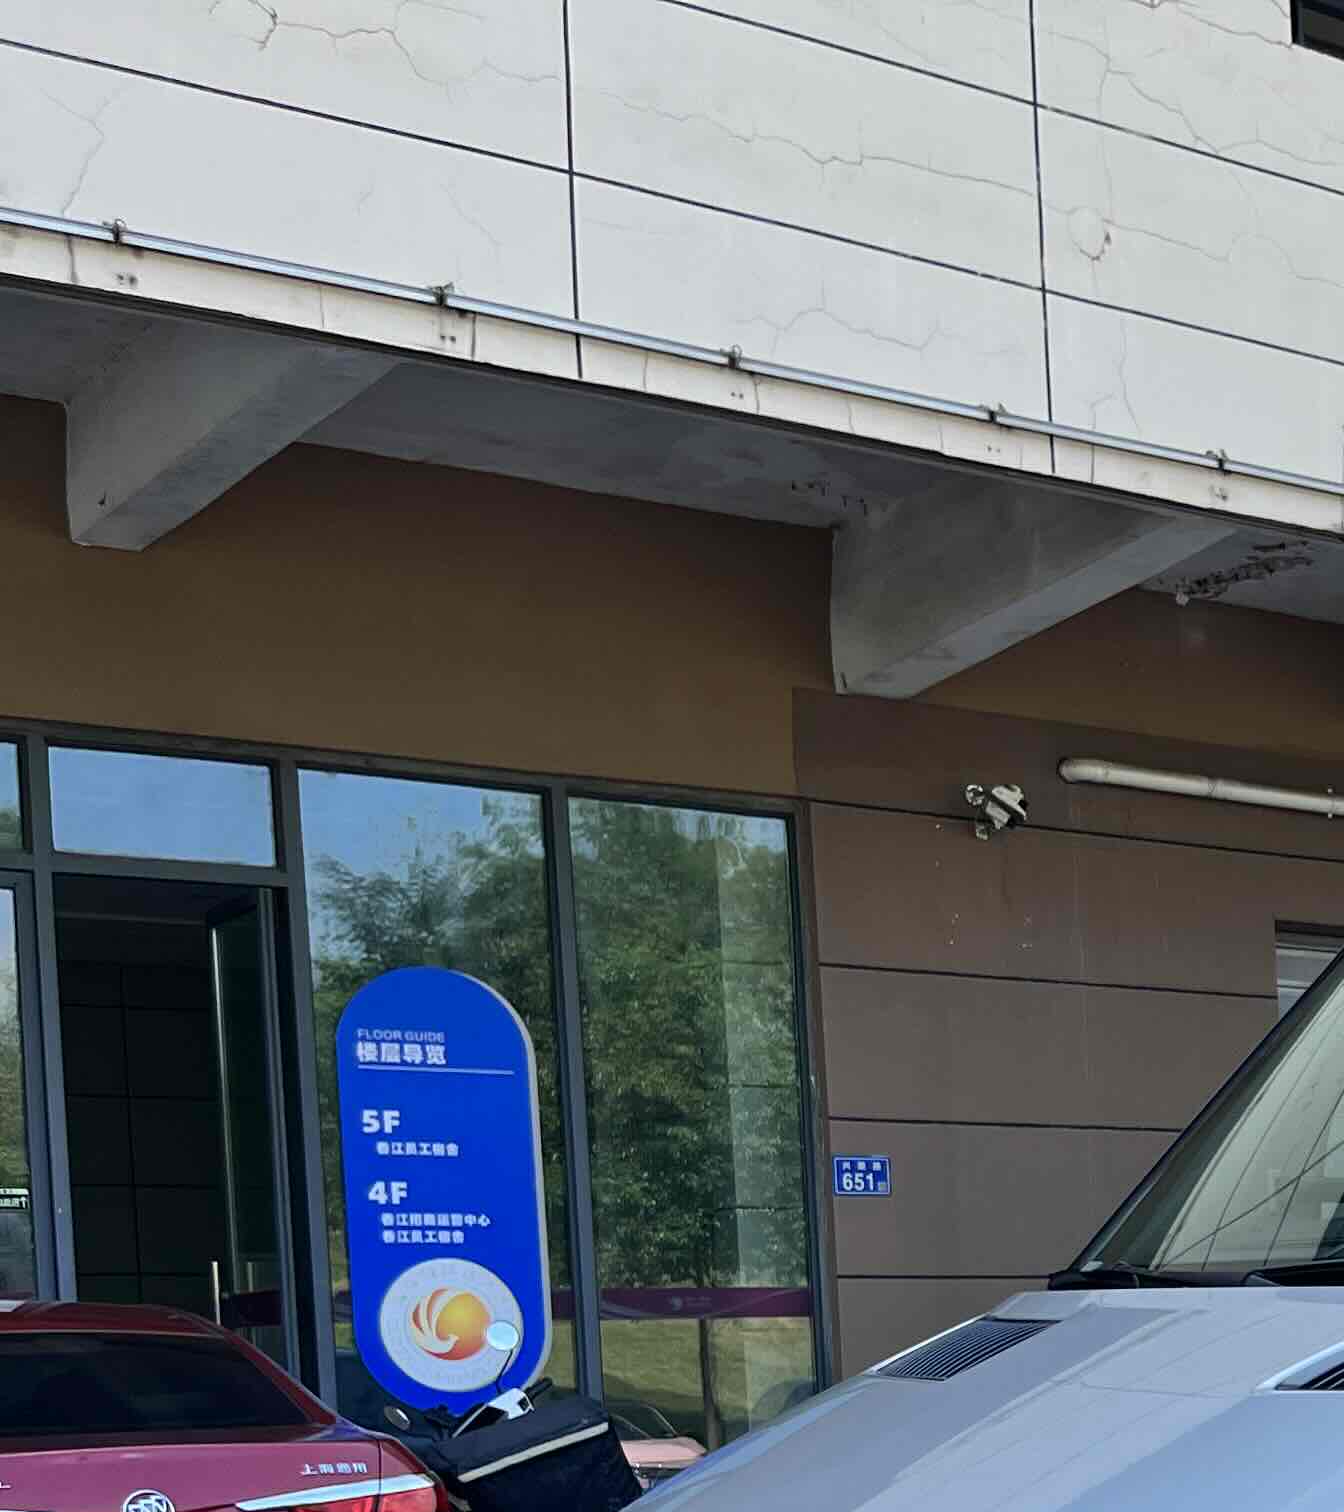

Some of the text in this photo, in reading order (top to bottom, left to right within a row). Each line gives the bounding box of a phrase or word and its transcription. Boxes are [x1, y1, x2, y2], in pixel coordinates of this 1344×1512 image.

[357, 1028, 445, 1043] FLOOR GUIDE
[362, 1109, 400, 1134] 5F
[368, 1180, 408, 1205] 4F
